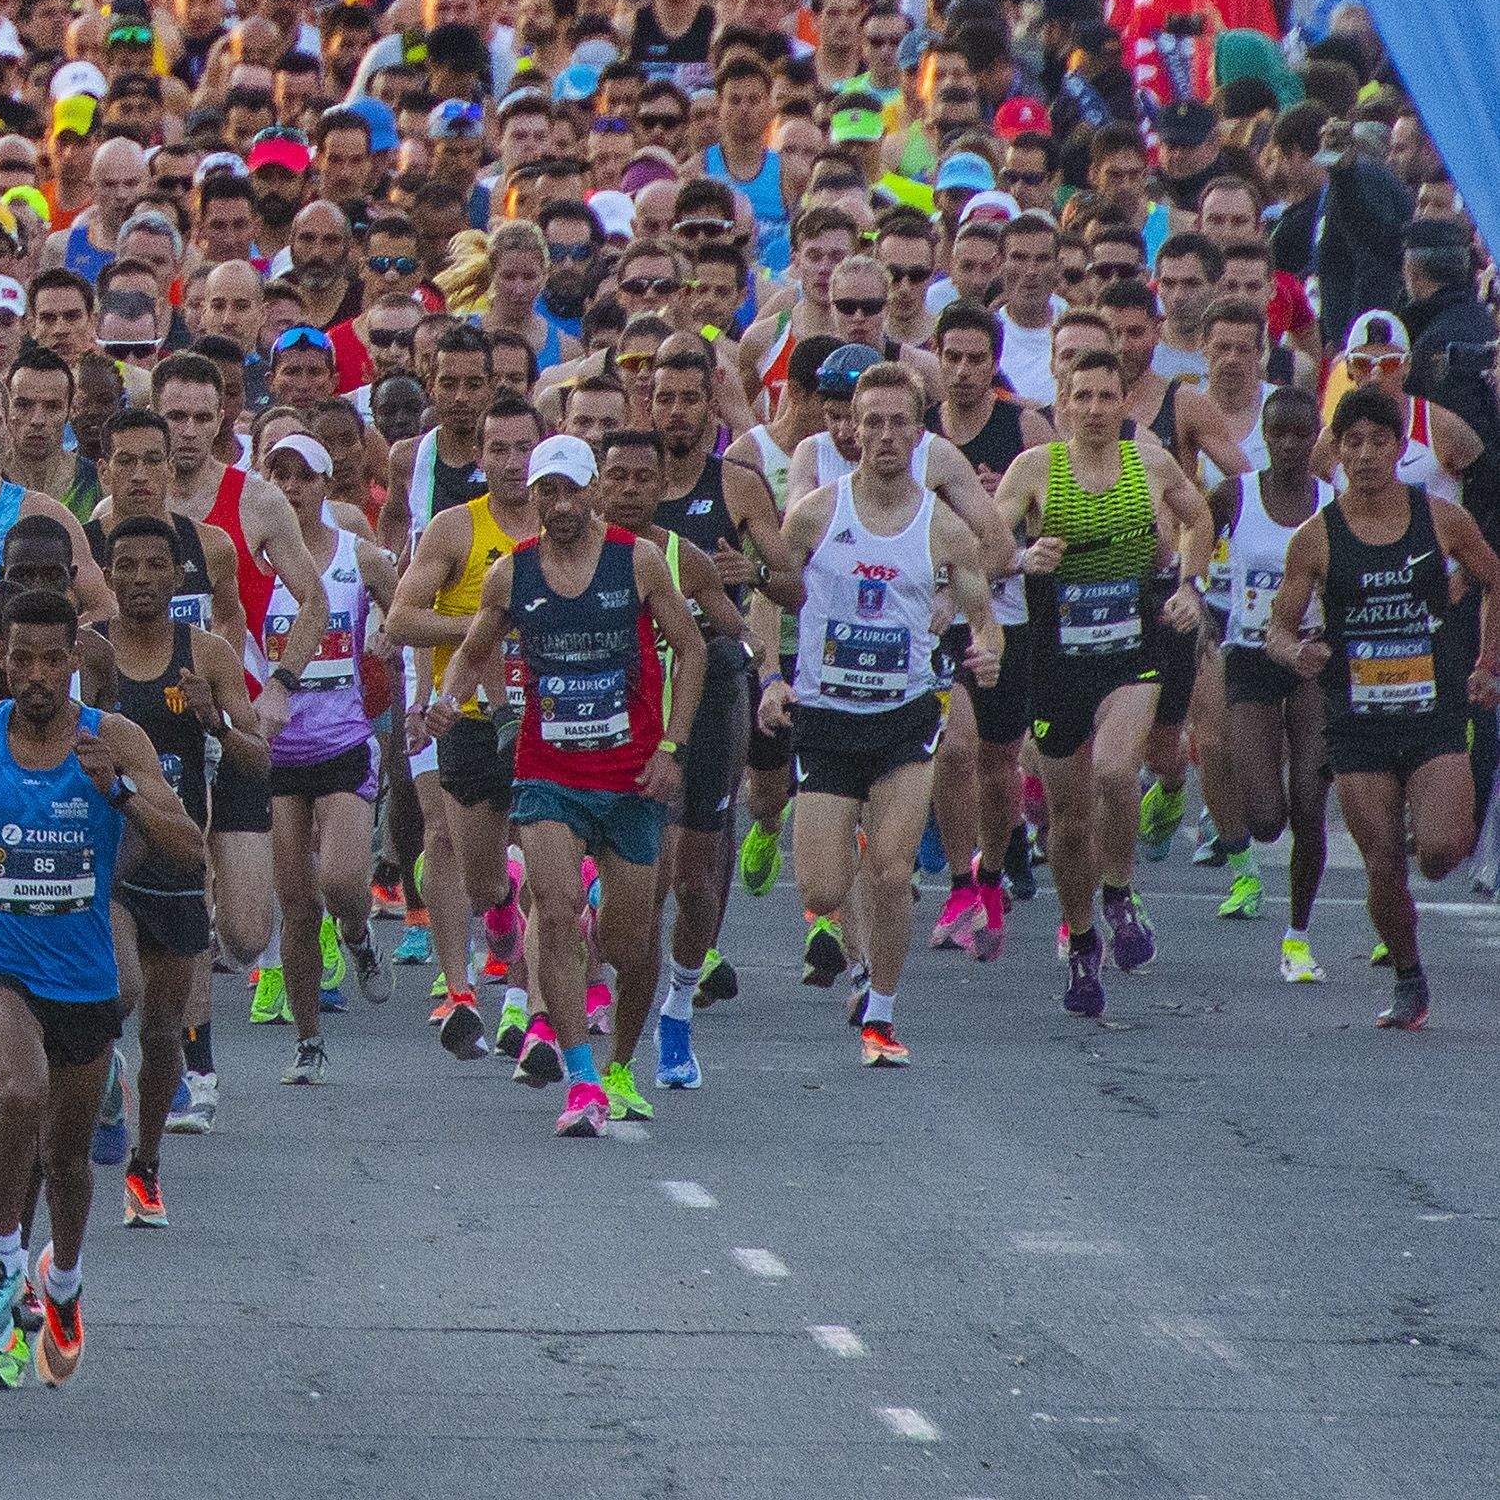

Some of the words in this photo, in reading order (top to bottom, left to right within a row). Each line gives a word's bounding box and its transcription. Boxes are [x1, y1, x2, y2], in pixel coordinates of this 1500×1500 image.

[1083, 583, 1131, 599] ZURICH
[853, 629, 903, 643] ZURICH
[1376, 644, 1426, 657] ZURICH
[568, 674, 616, 692] ZURICH
[577, 702, 595, 716] 27
[26, 828, 86, 843] ZURICH
[32, 857, 56, 873] 85
[12, 883, 74, 897] ADHANOM
